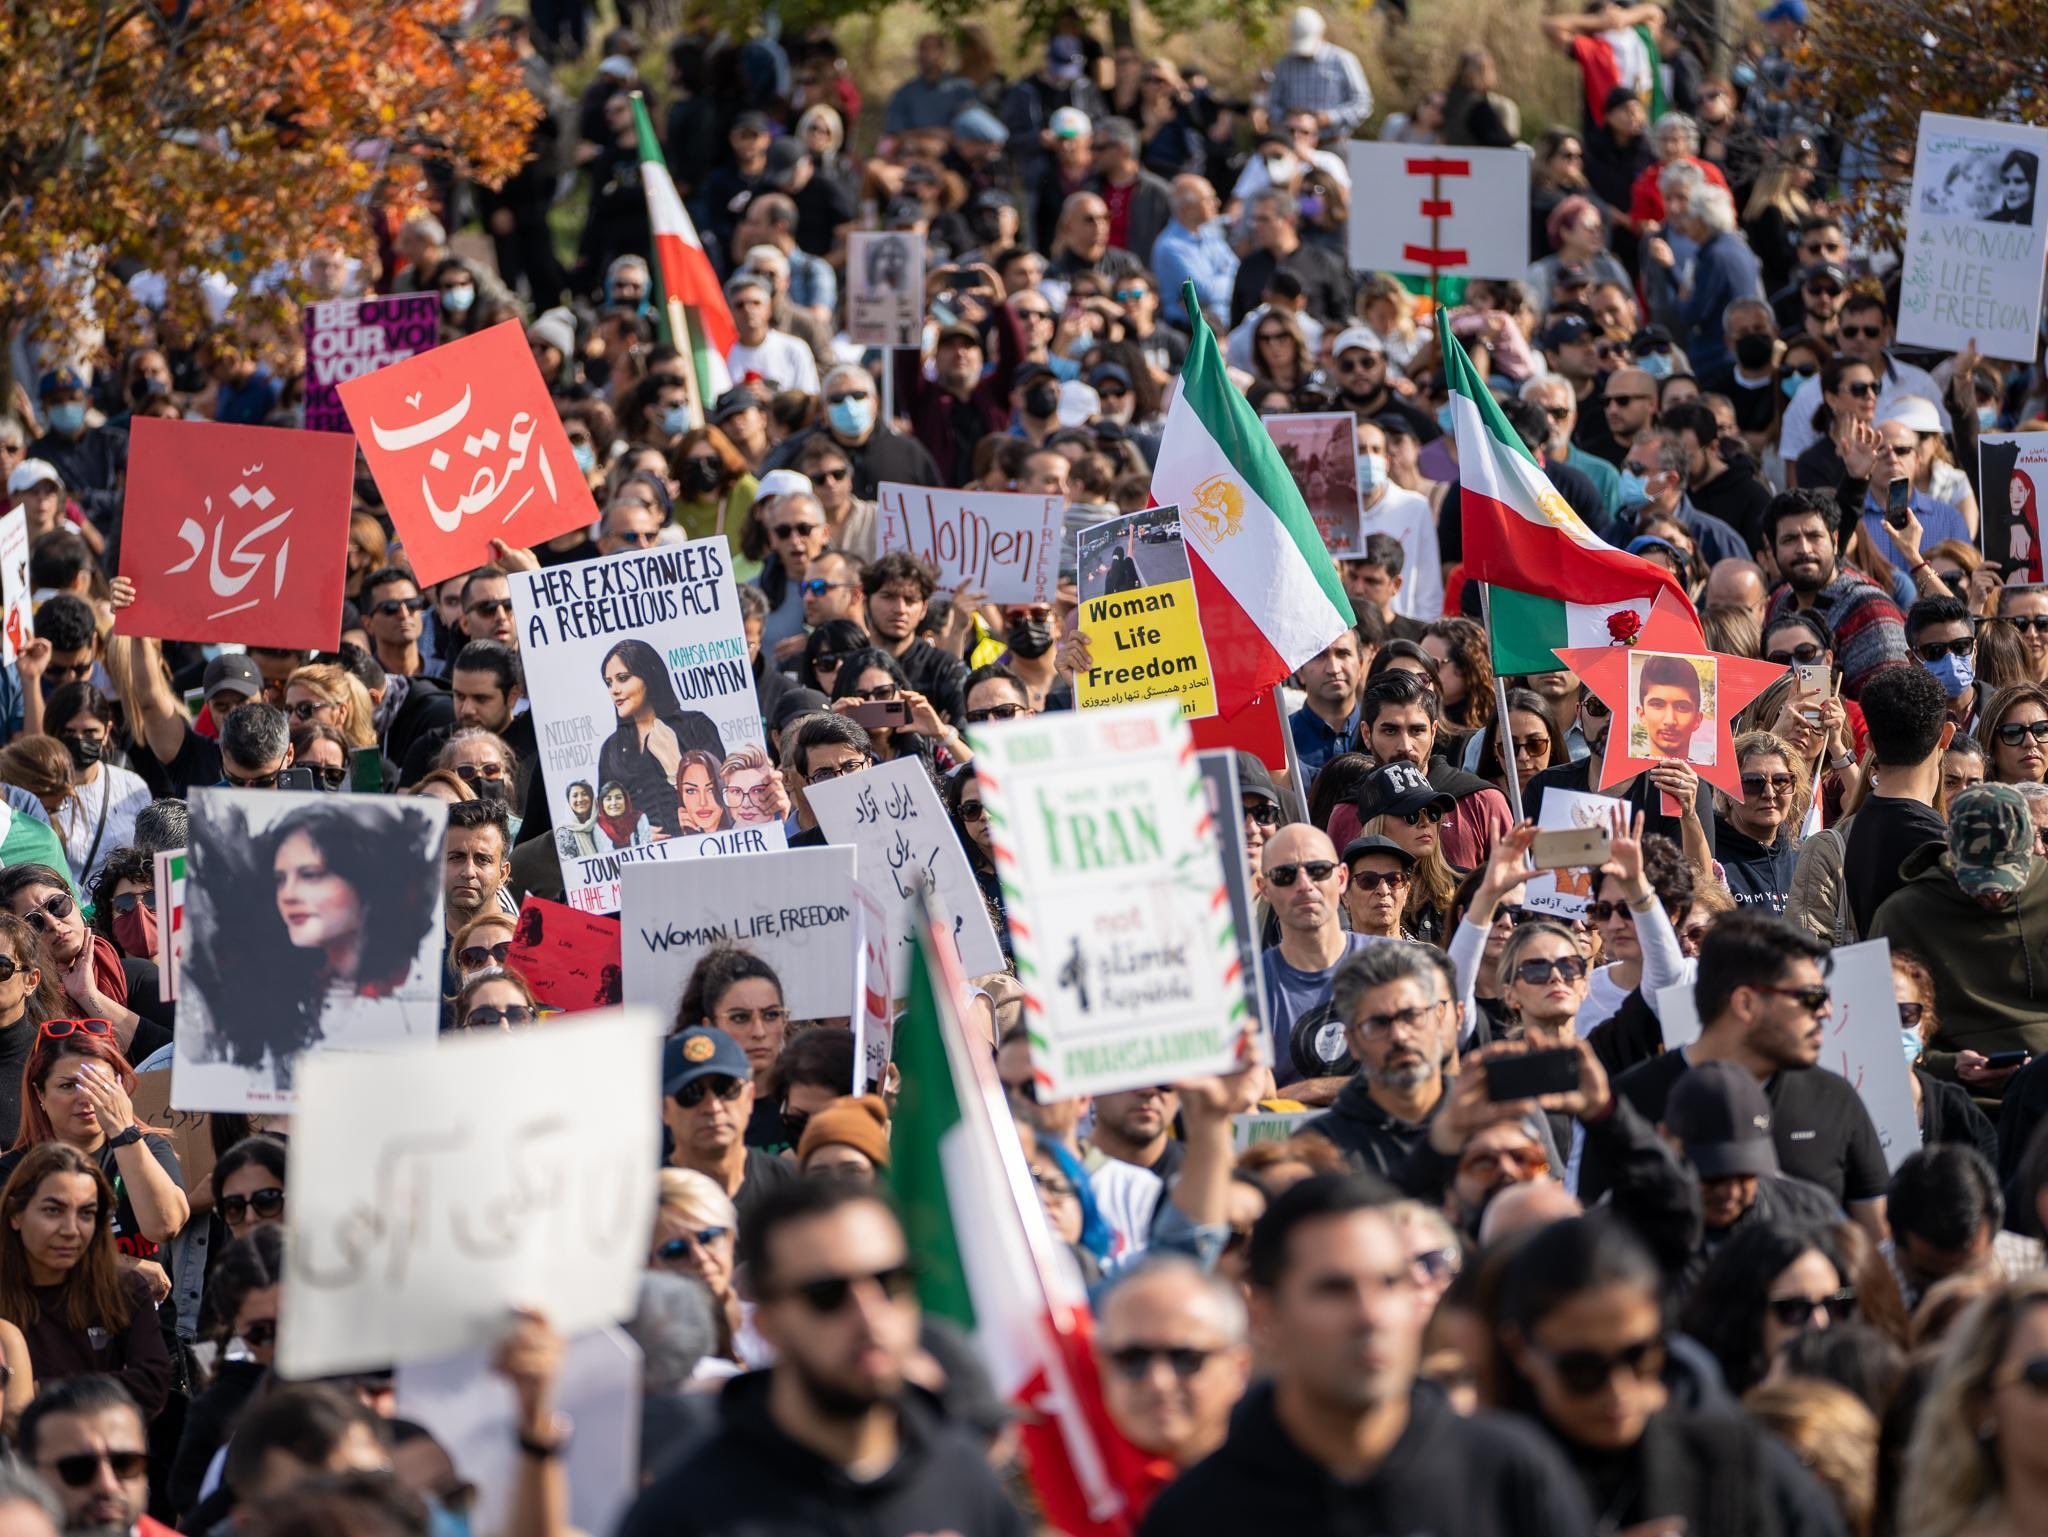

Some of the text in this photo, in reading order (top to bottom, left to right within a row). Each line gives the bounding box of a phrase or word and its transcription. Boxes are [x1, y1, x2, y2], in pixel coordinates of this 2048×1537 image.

[1941, 224, 2036, 261] WOMAN
[1940, 259, 1995, 295] LIFE
[314, 301, 360, 330] BE
[1932, 294, 2031, 335] FREEDOM
[311, 325, 386, 356] OUR
[528, 545, 724, 609] HER EXISTANCE IS
[528, 578, 721, 648] A REBELLIOUS ACT
[1089, 592, 1176, 623] Woman
[707, 635, 747, 661] AMINI
[1114, 625, 1162, 652] Life
[674, 659, 749, 701] WOMAN
[1087, 654, 1198, 688] Freedom
[547, 742, 597, 772] HAMEDI
[885, 782, 919, 821] ایران
[1530, 897, 1561, 910] آزادی
